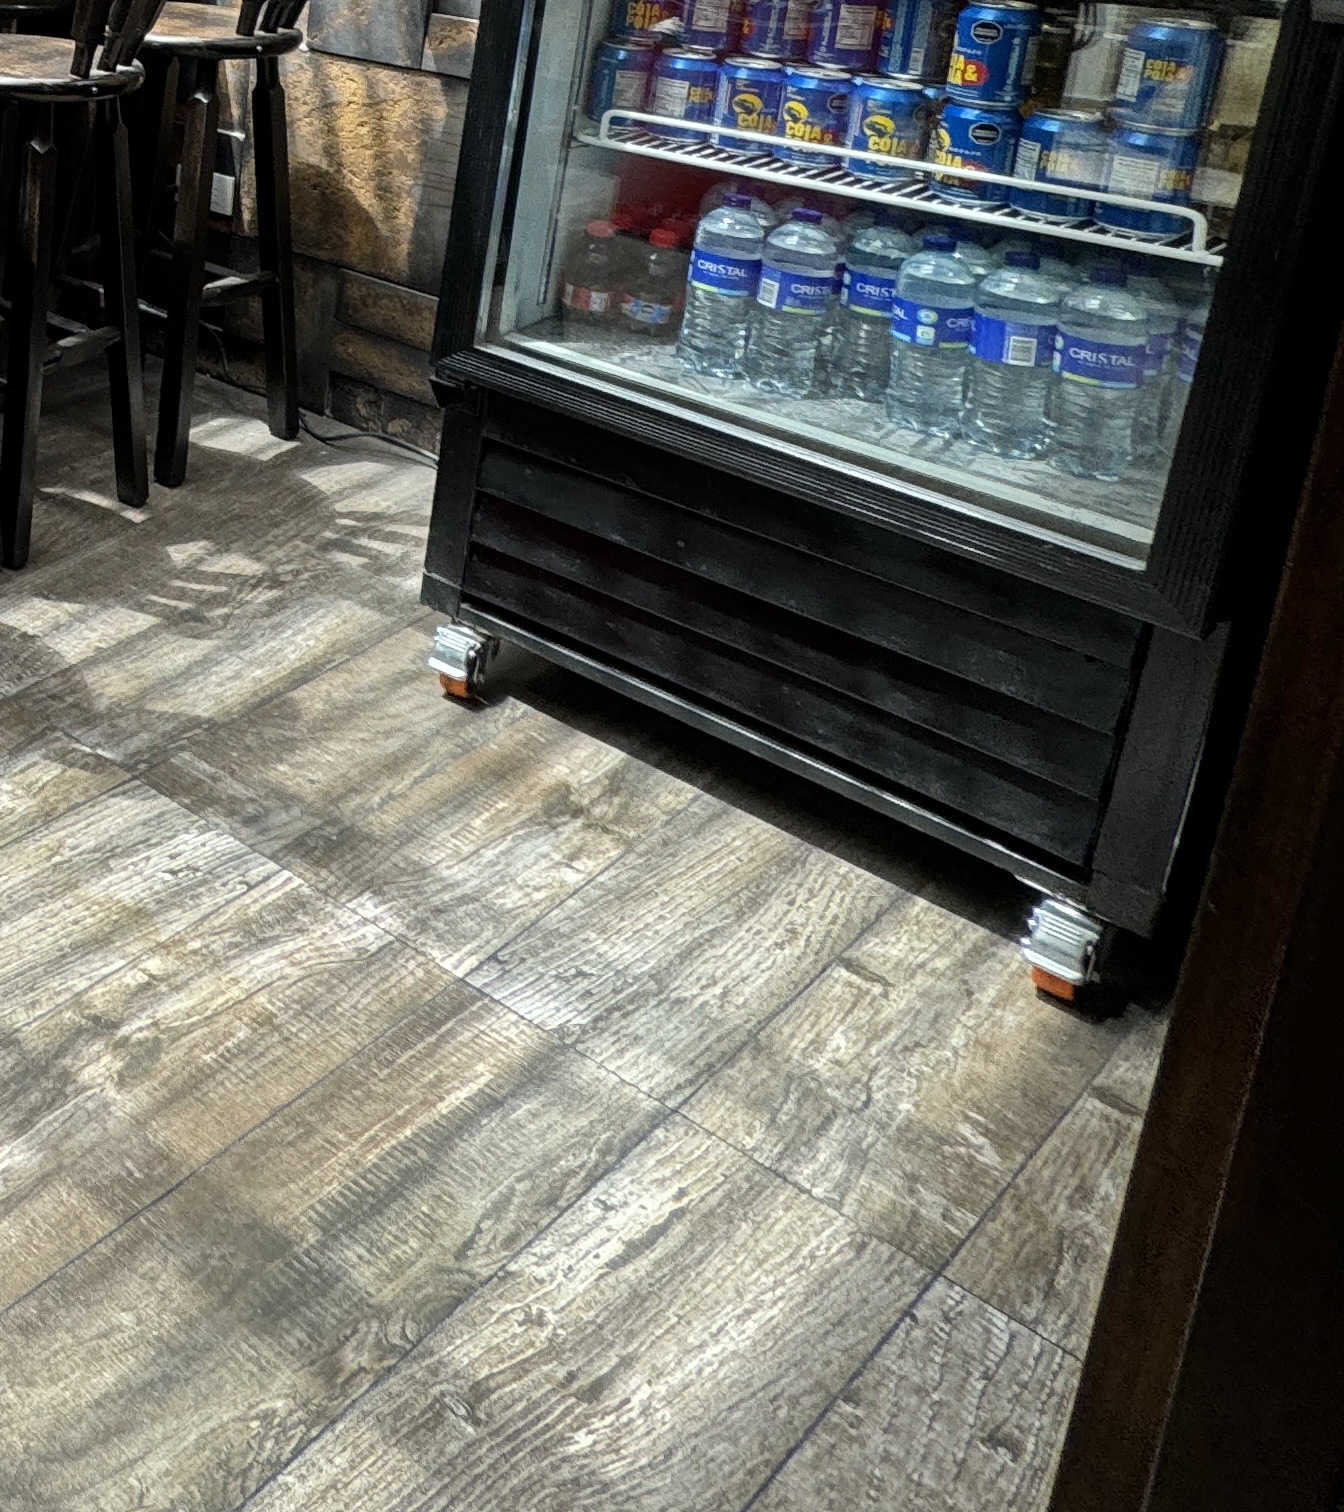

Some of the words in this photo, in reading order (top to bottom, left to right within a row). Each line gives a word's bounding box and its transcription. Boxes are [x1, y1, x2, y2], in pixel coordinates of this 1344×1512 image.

[697, 259, 748, 278] CRISTAL
[856, 282, 896, 297] CRIST
[1069, 346, 1136, 368] CRISTAL
